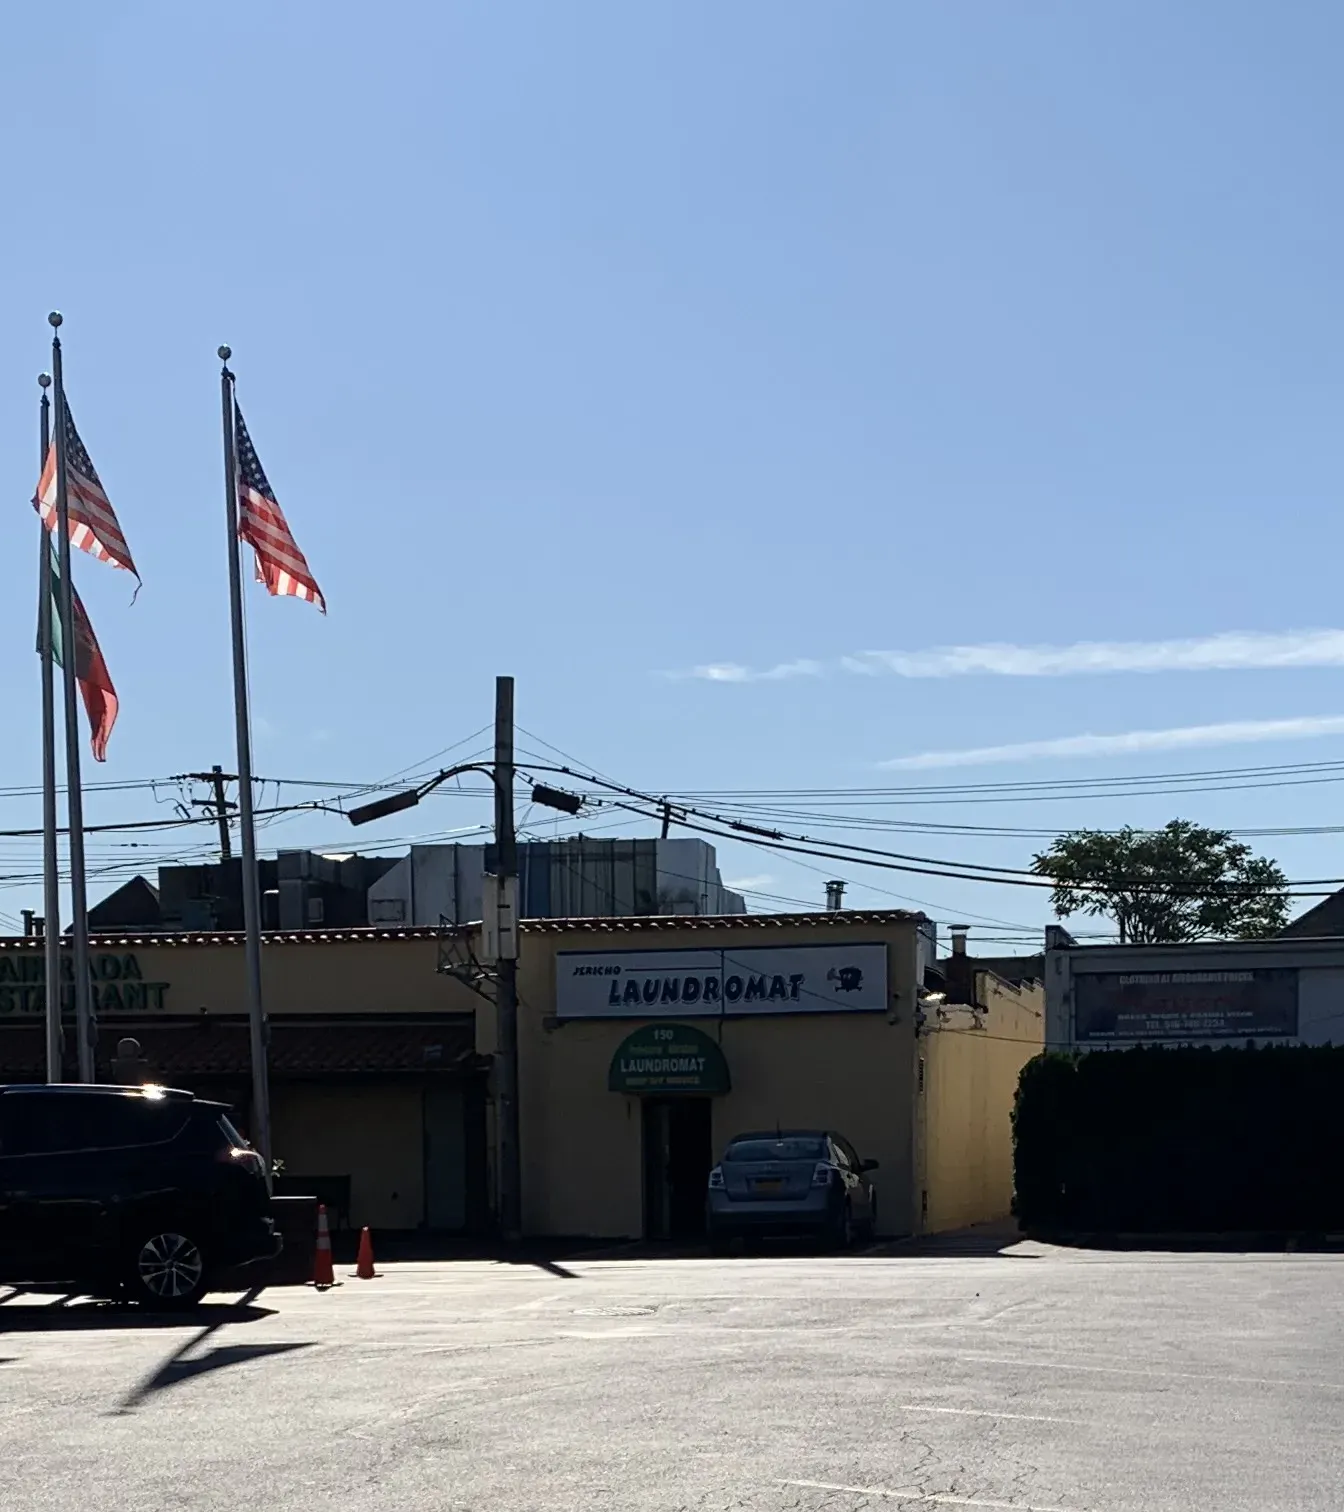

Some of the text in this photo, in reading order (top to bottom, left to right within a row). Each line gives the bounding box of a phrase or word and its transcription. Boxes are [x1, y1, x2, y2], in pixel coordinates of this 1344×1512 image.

[573, 965, 621, 976] JERICHO
[608, 974, 805, 1006] LAUNDROMAT
[653, 1029, 674, 1040] 150
[620, 1057, 706, 1073] LAUNDROMAT
